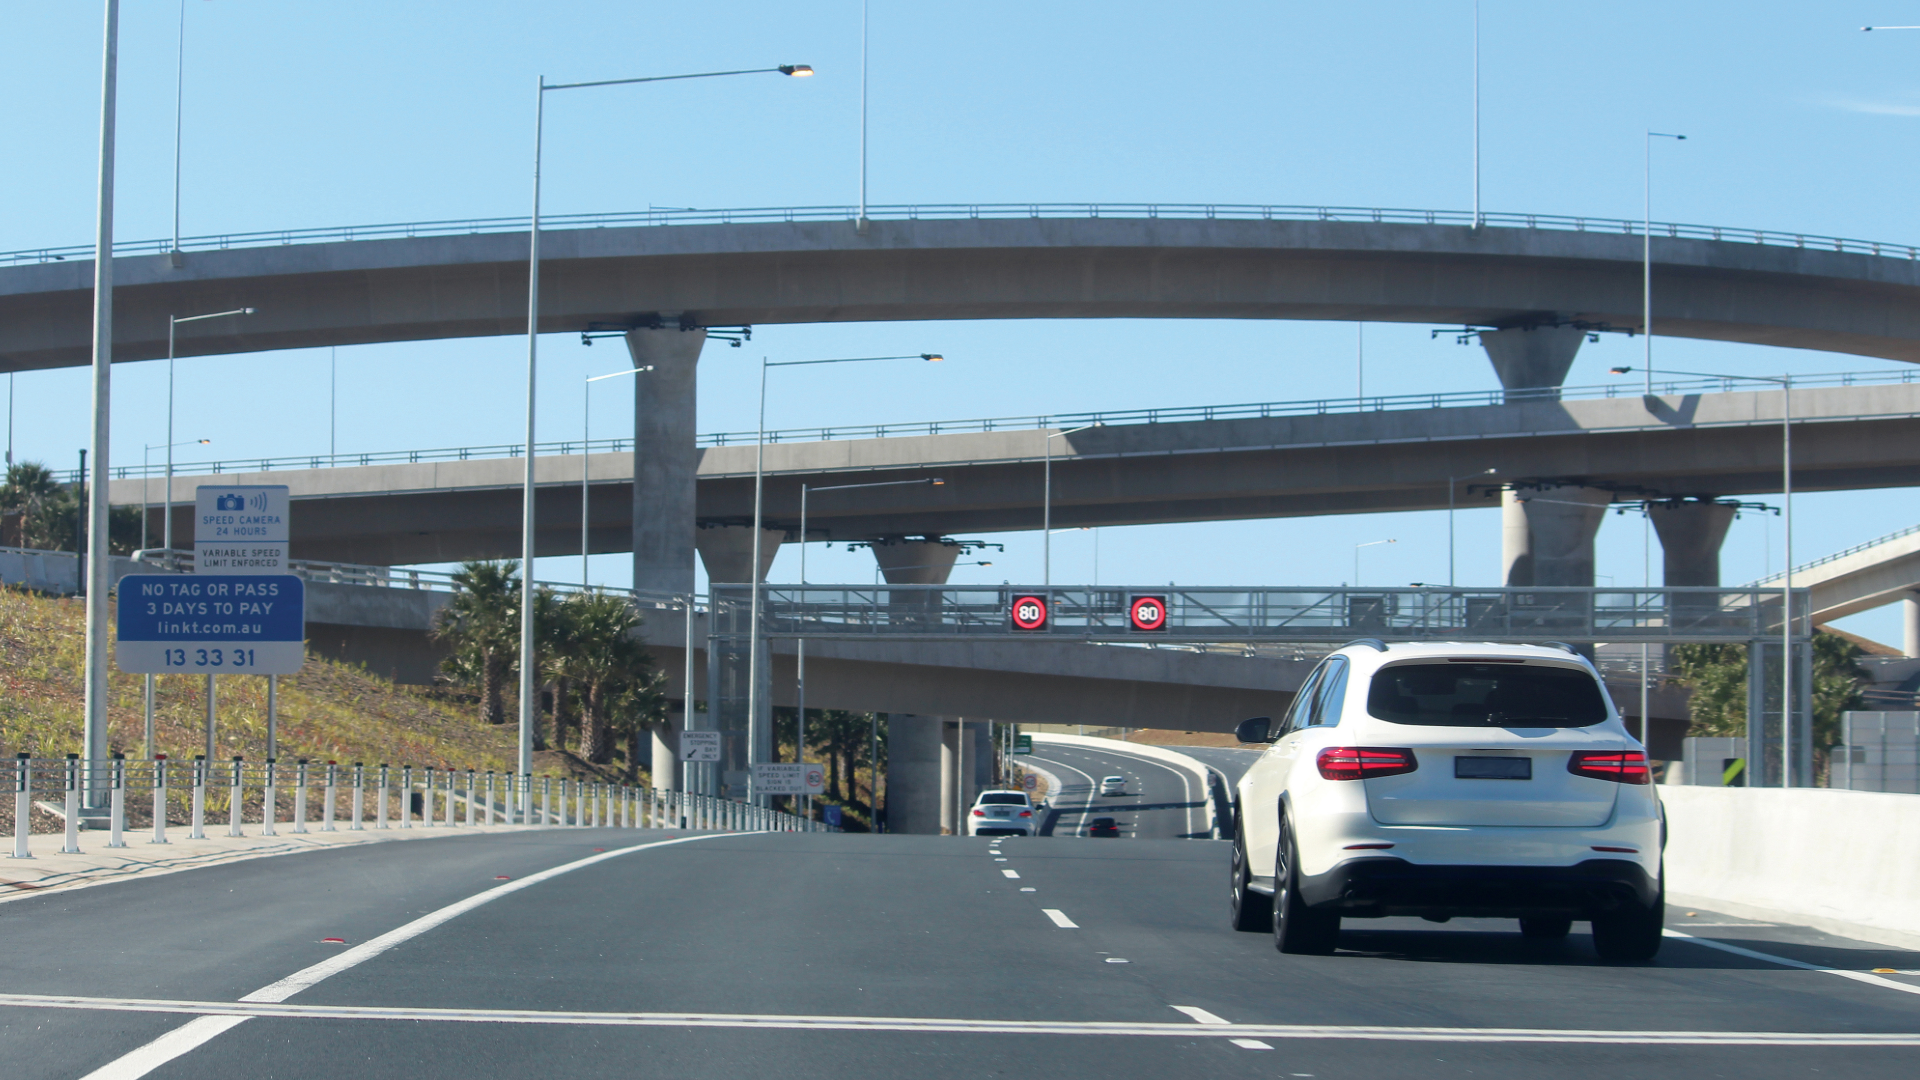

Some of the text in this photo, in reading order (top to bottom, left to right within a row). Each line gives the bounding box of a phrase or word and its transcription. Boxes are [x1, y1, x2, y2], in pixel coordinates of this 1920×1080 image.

[203, 516, 281, 525] SPEED CAMERA
[216, 527, 267, 535] 24 HOURS
[202, 549, 280, 557] VARIABLE SPEED
[204, 559, 278, 567] LIMIT ENFORCED
[142, 583, 279, 596] NO TAG OR PASS
[147, 602, 273, 615] 3 DAYS TO PAY
[1018, 605, 1039, 620] 80
[1137, 606, 1158, 621] 80
[158, 621, 262, 634] linkt.com.au
[165, 648, 255, 666] 13 33 31
